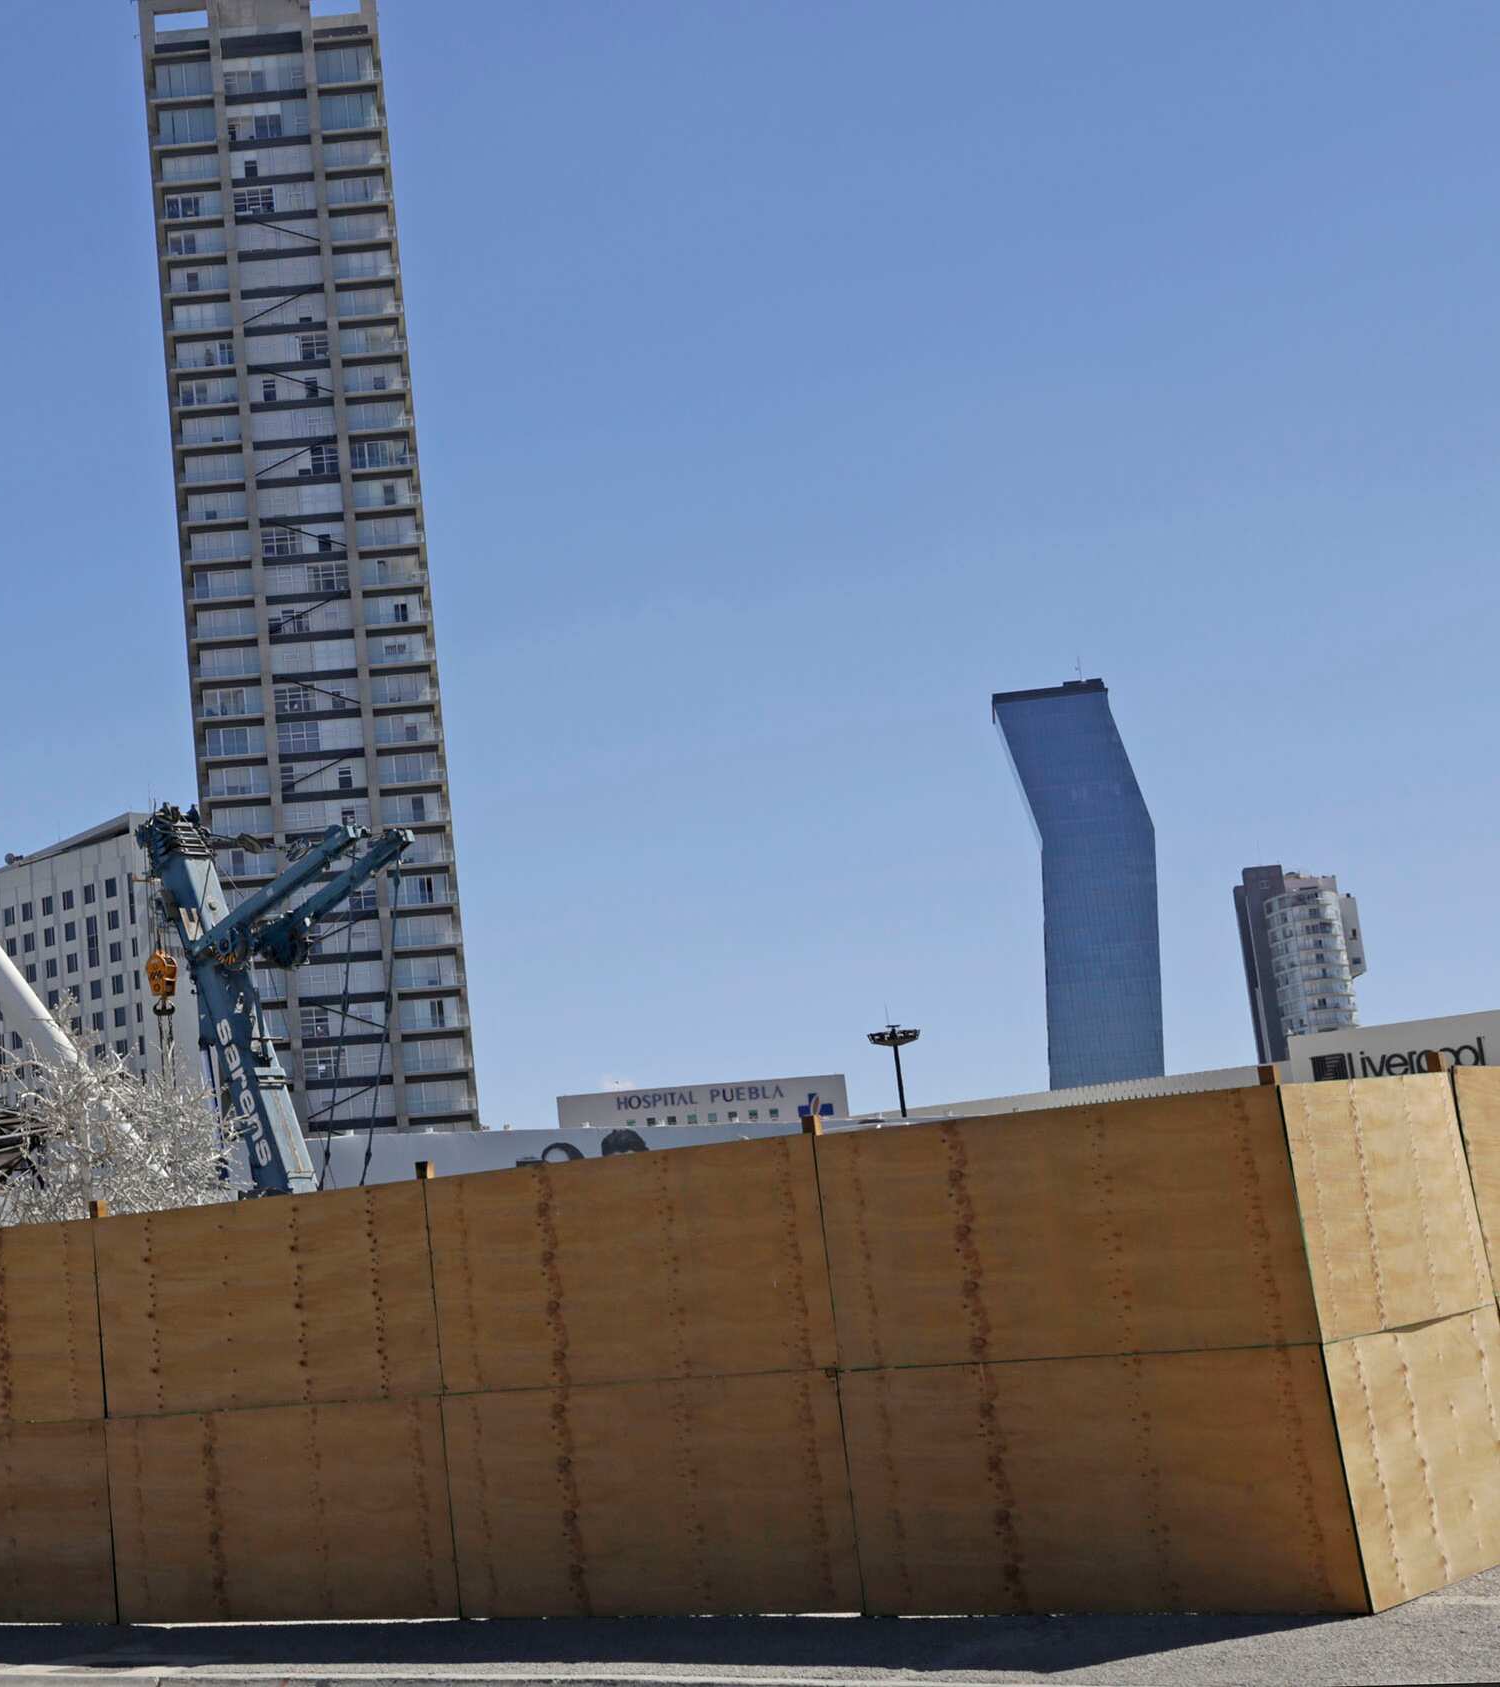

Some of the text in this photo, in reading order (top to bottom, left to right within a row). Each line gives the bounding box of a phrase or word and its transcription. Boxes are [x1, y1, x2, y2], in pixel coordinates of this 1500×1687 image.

[216, 1018, 271, 1166] sarens
[616, 1085, 785, 1111] HOSPITAL PUEBLA
